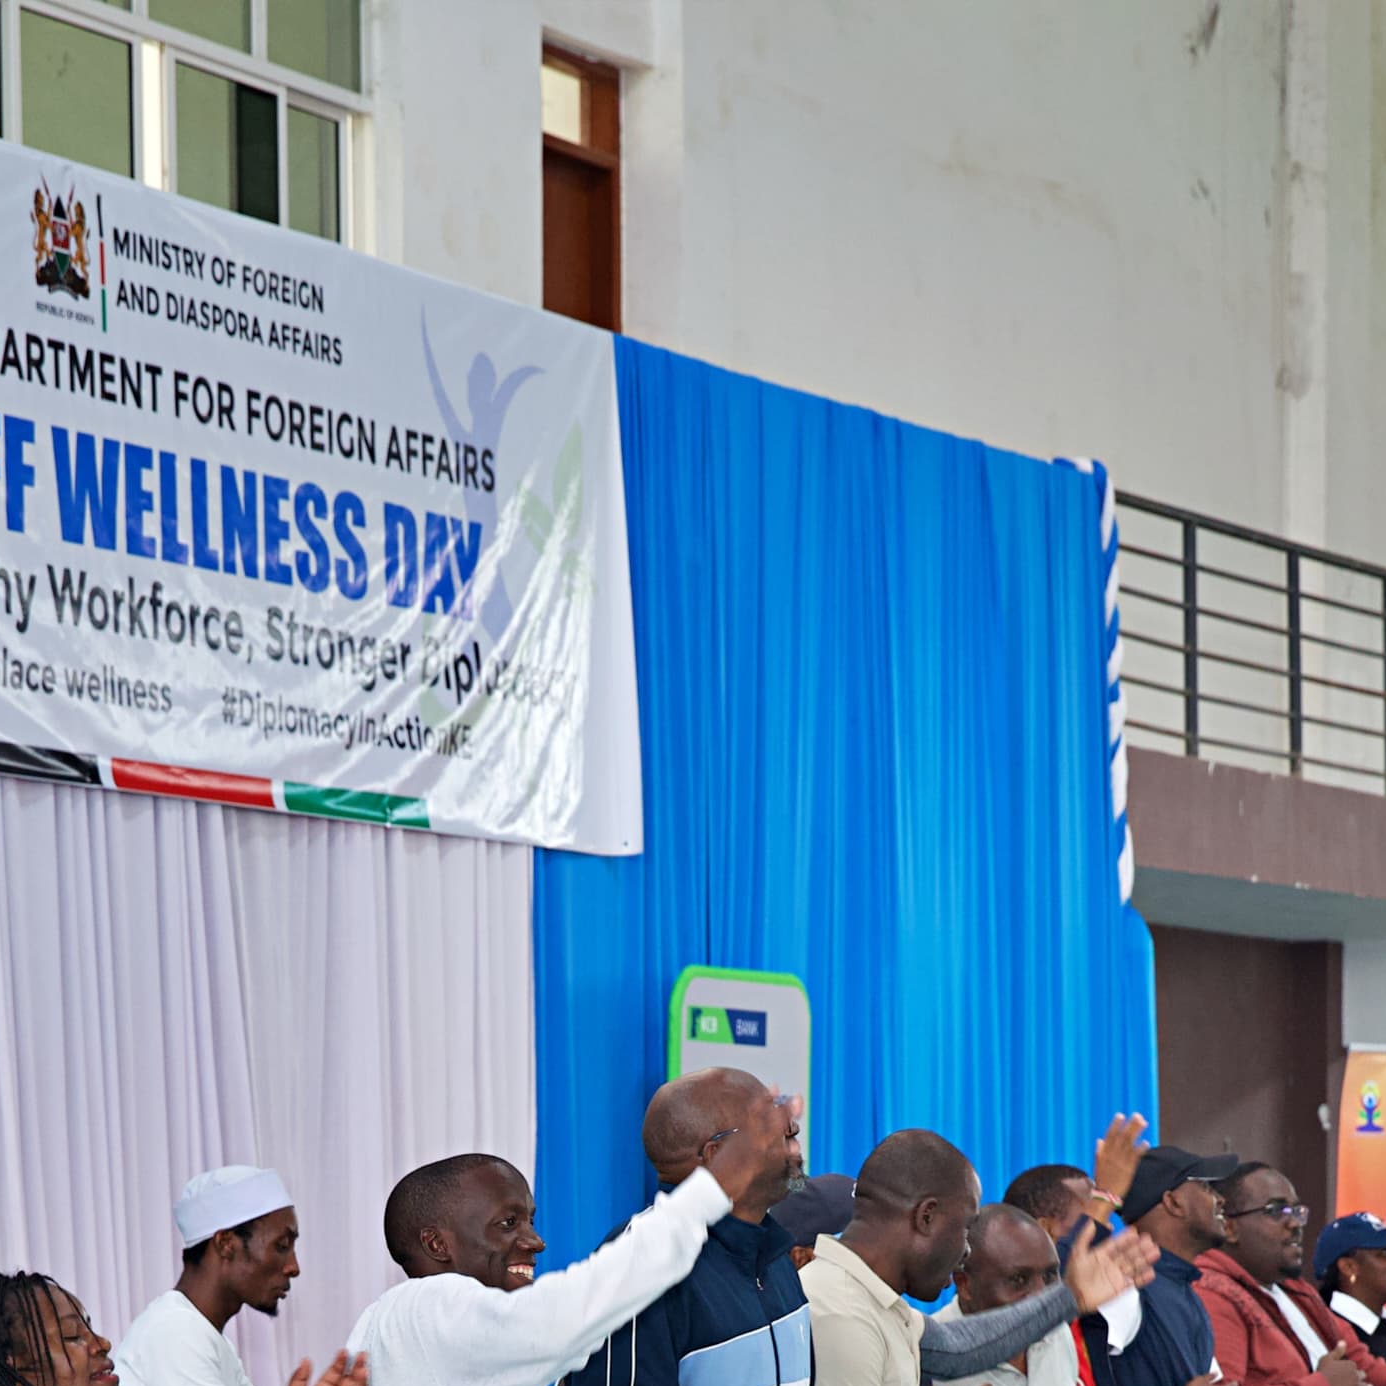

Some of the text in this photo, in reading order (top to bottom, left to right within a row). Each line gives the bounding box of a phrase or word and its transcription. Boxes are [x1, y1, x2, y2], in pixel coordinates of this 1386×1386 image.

[113, 227, 324, 314] MINISTRY OF FOREIGN
[116, 278, 343, 366] AND DIASPORA AFFAIRS
[173, 370, 237, 432] FOR
[246, 388, 376, 466] FOREIGN
[385, 425, 496, 494] AFFAIRS
[51, 424, 368, 601] WELLNESS
[383, 501, 482, 622] DAY
[46, 563, 253, 665] Workforce,
[265, 606, 412, 692] Stronger
[64, 664, 172, 714] wellness
